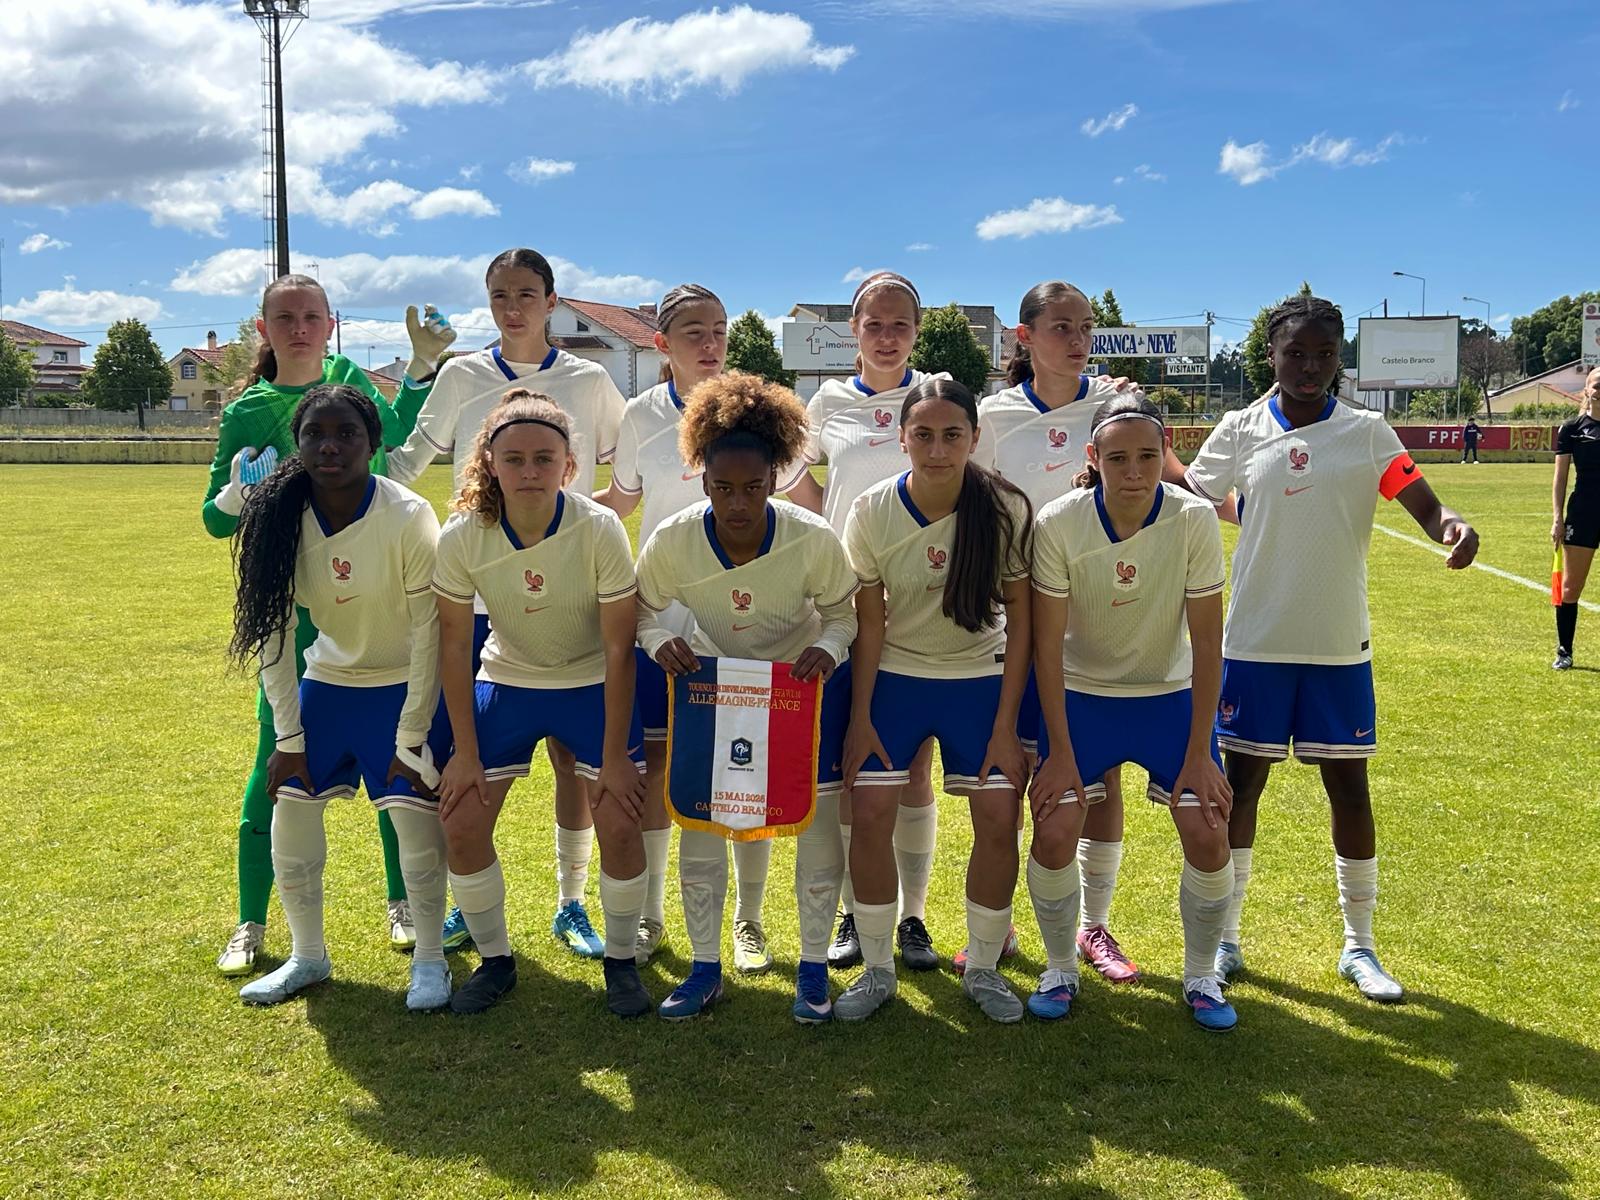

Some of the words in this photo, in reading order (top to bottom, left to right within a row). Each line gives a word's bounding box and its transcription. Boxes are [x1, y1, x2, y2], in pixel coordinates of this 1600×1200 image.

[1090, 334, 1137, 354] BRANCA
[1147, 333, 1177, 354] NEVE
[1382, 356, 1409, 364] Castelo
[1410, 356, 1435, 364] Branco
[1169, 365, 1205, 373] VISITANTE
[1429, 430, 1460, 444] FPF
[688, 693, 800, 711] ALLEMAGNE-FRANCE
[714, 791, 724, 800] 15
[725, 791, 745, 802] MAI
[695, 802, 740, 814] CASTELO
[741, 805, 783, 816] BRANCO
